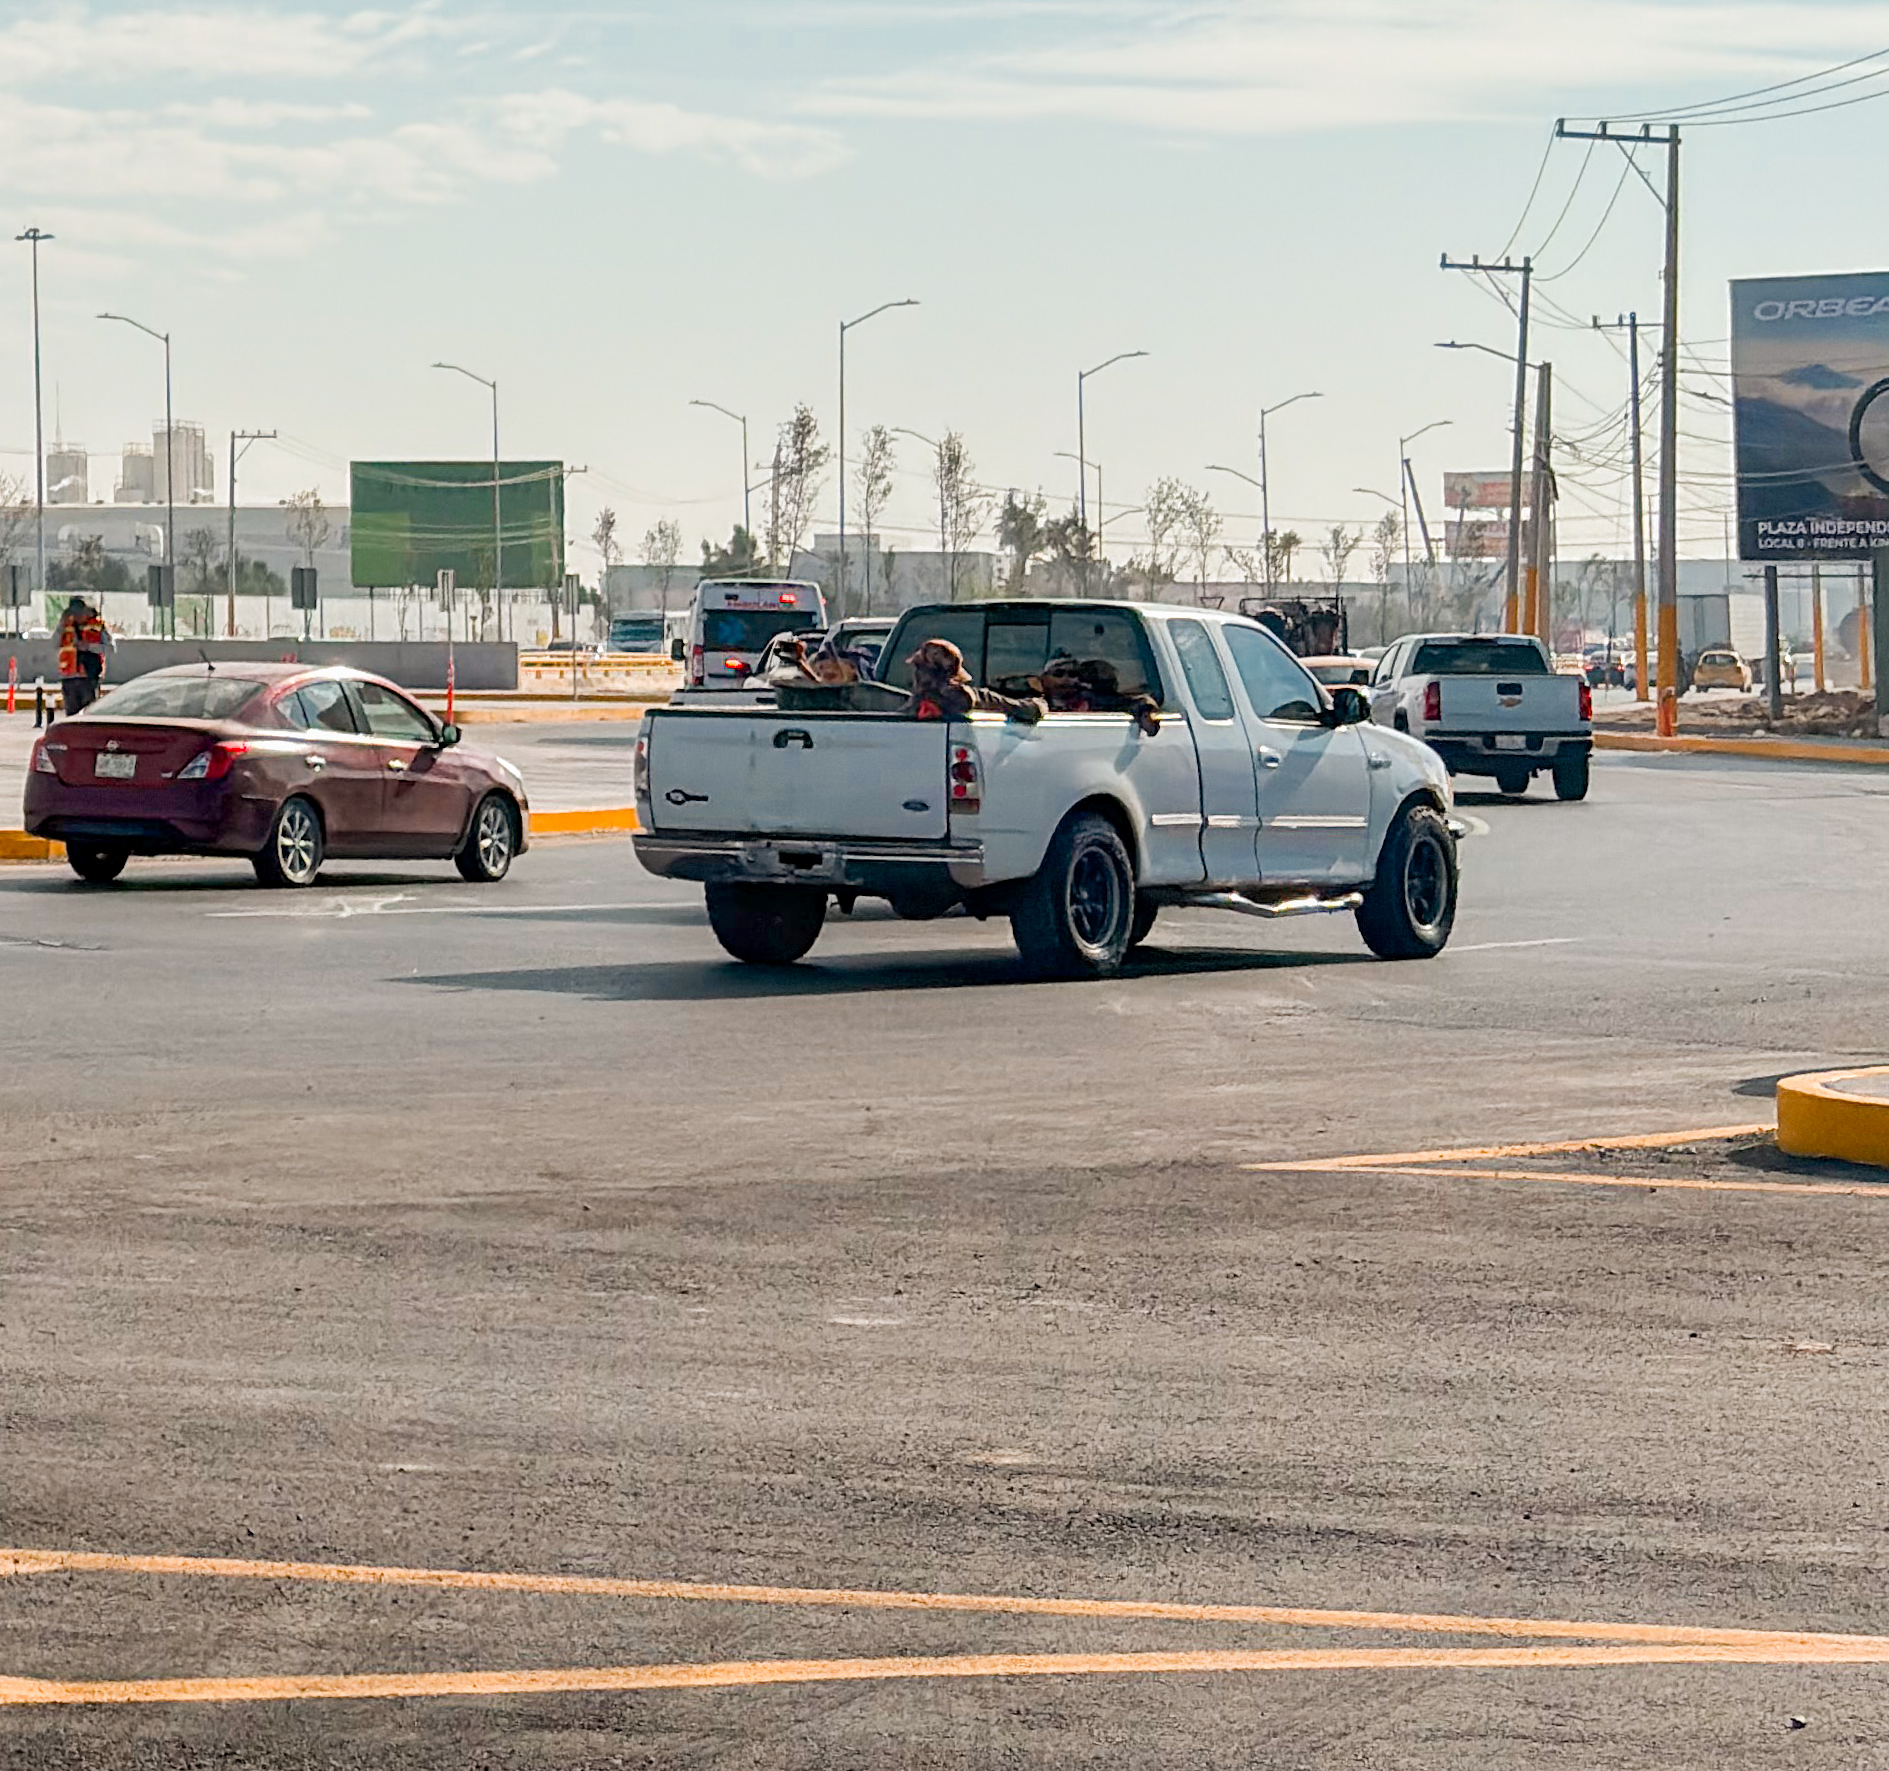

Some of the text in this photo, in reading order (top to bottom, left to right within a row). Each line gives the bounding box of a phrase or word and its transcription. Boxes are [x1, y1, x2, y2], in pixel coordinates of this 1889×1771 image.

[1758, 520, 1889, 535] PLAZA INDEPEND
[1758, 538, 1795, 548] LOCAL
[1814, 537, 1856, 548] FRENTE
[1859, 537, 1868, 548] A
